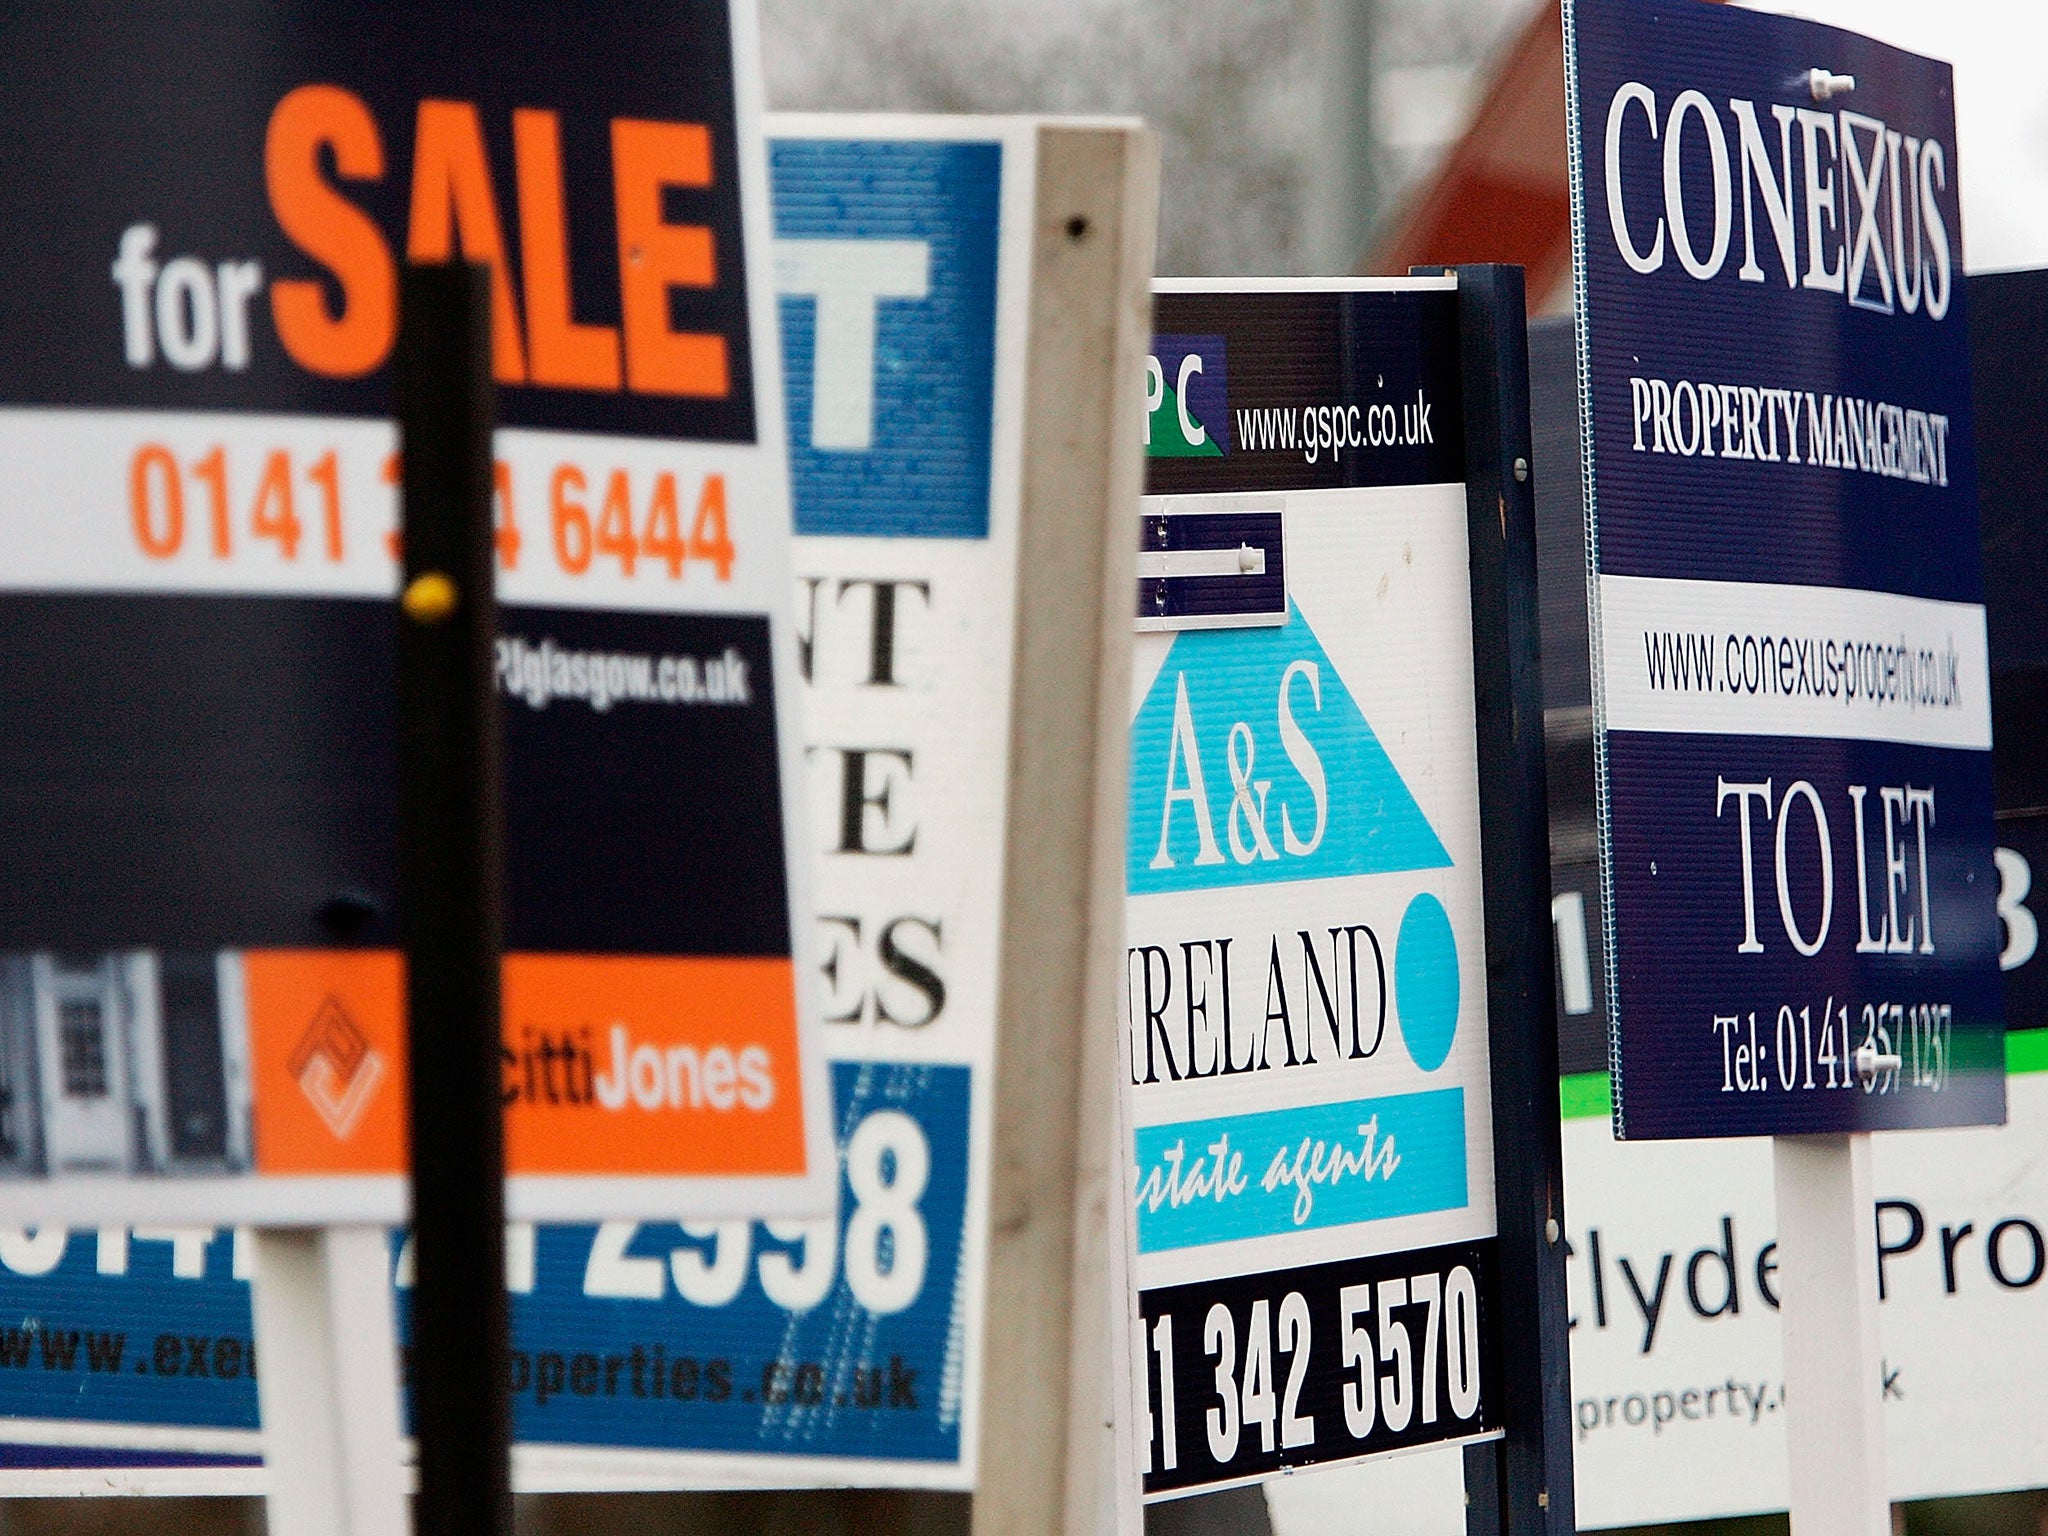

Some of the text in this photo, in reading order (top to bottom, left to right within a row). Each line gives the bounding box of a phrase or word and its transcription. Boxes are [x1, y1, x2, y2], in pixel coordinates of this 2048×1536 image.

[111, 84, 729, 398] for SALE
[1605, 82, 1951, 321] CONEXUS
[1236, 390, 1434, 464] www.gspc.co.uk
[1630, 377, 1949, 487] PROPERTY MANAGEMENT
[128, 442, 345, 564] 0141
[548, 462, 735, 583] 6444
[1149, 660, 1329, 870] A&S
[1717, 775, 1834, 957] TO
[1848, 783, 1936, 955] LET
[1713, 1014, 1767, 1092] Tel:
[1776, 995, 1854, 1092] 0141
[1262, 1114, 1401, 1226] agents
[1204, 1291, 1315, 1463] 342
[1340, 1265, 1481, 1439] 5570
